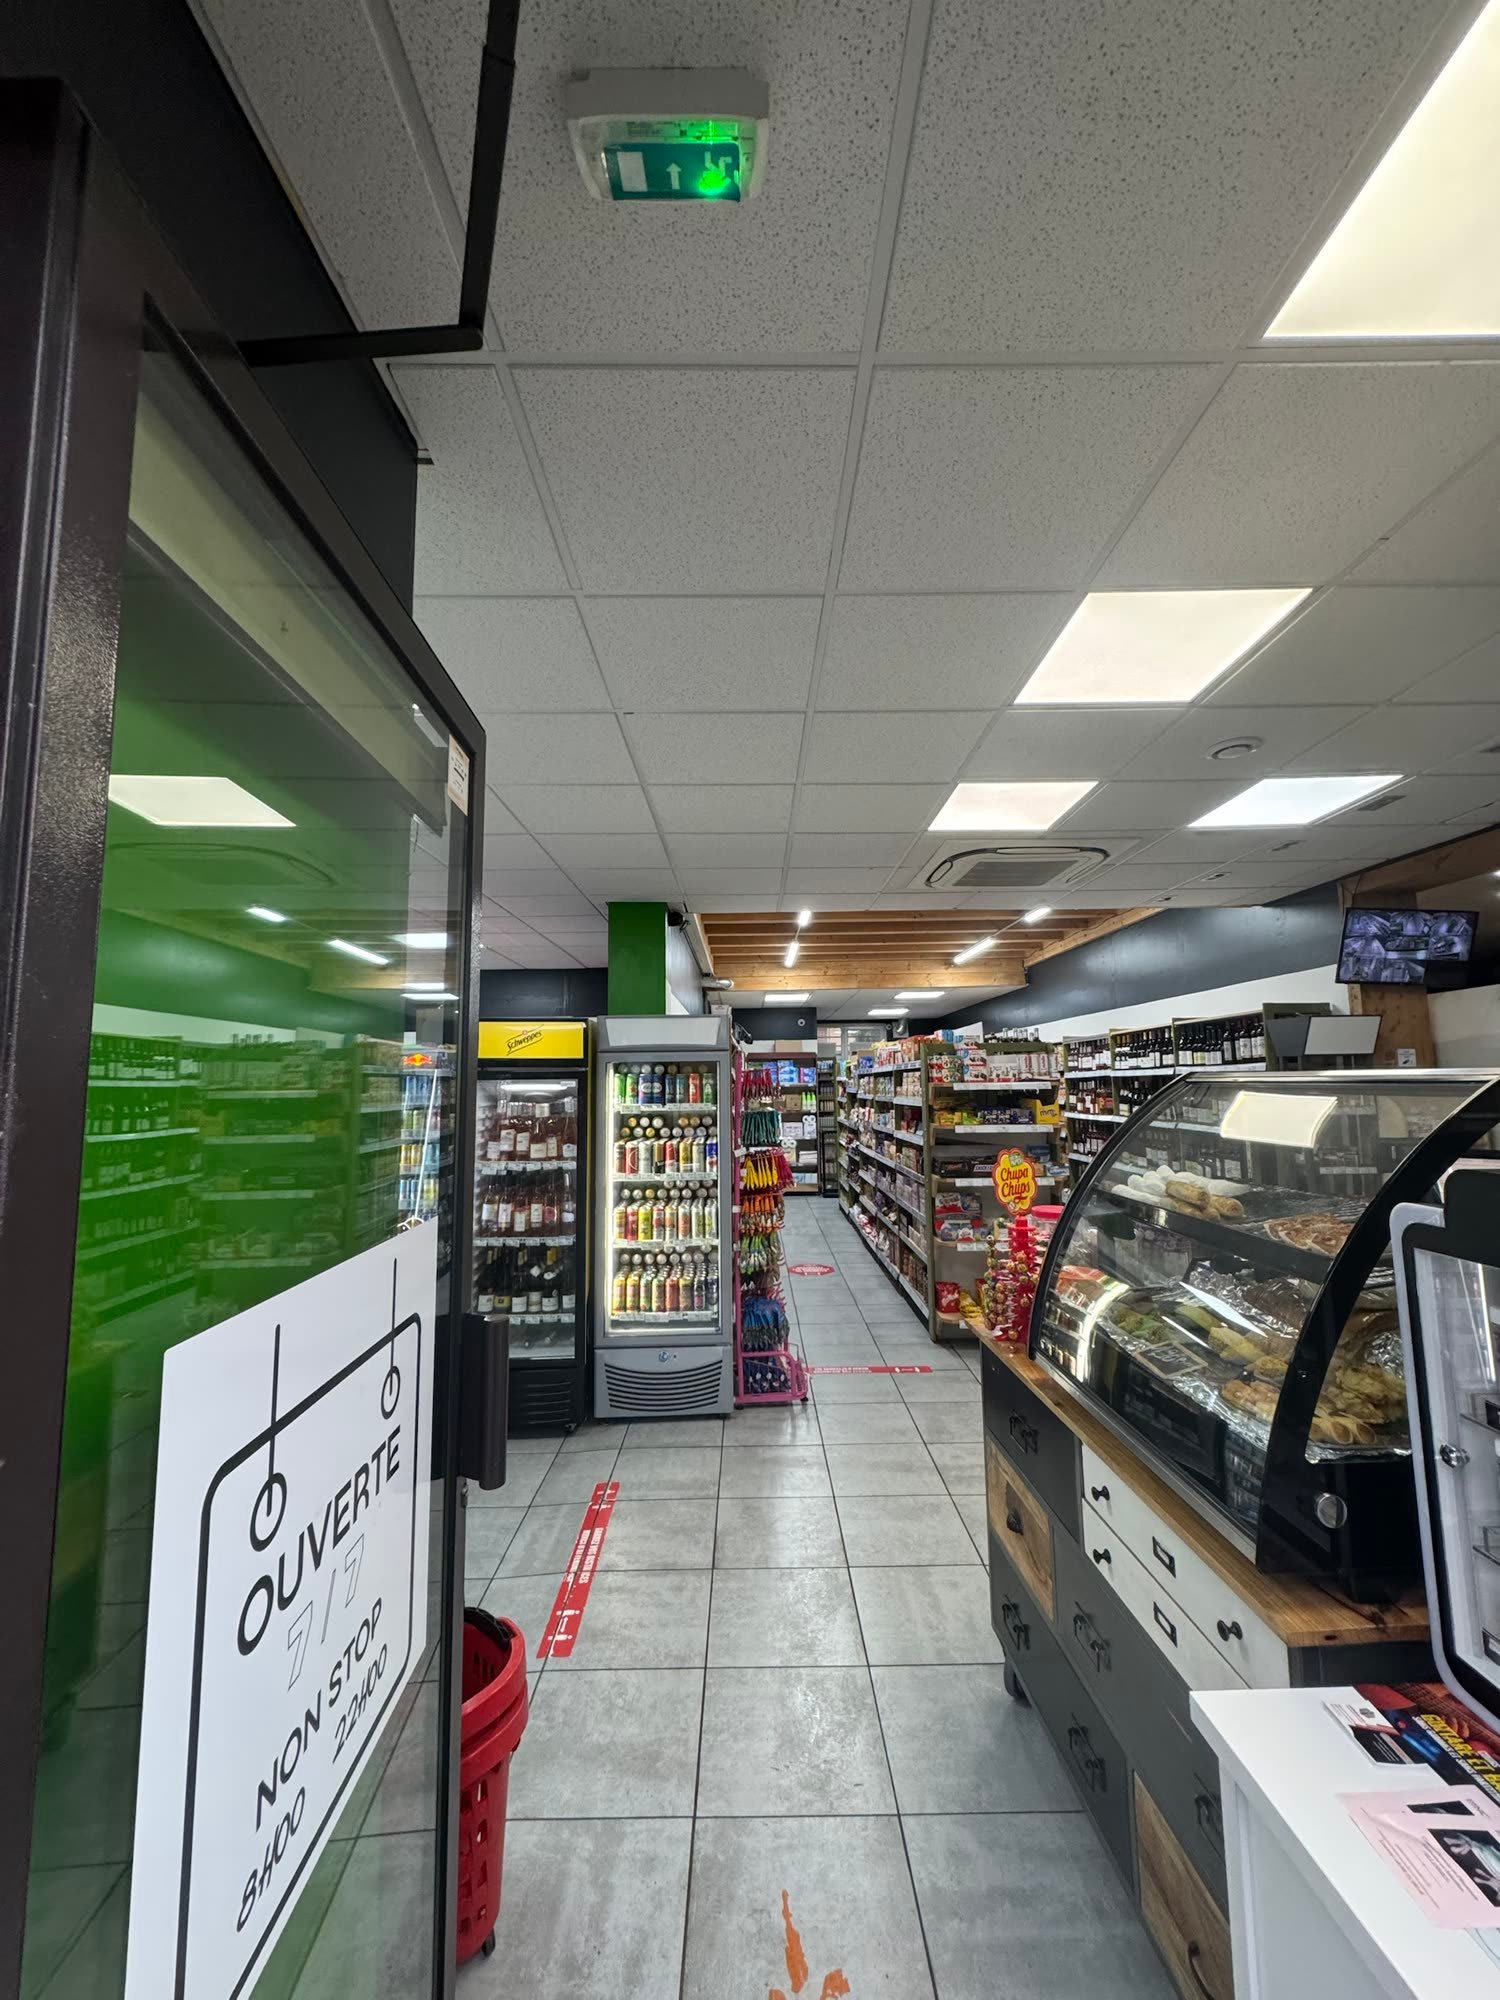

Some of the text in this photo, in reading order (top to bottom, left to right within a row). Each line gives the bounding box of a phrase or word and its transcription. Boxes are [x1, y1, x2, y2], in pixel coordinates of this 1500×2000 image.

[507, 1030, 542, 1053] Schweppes
[1000, 1167, 1029, 1183] Chupa
[1001, 1181, 1030, 1199] Chups
[237, 1424, 400, 1656] OUVERTE
[256, 1597, 382, 1833] NON STOP
[236, 1643, 388, 1933] 8H00 22H00
